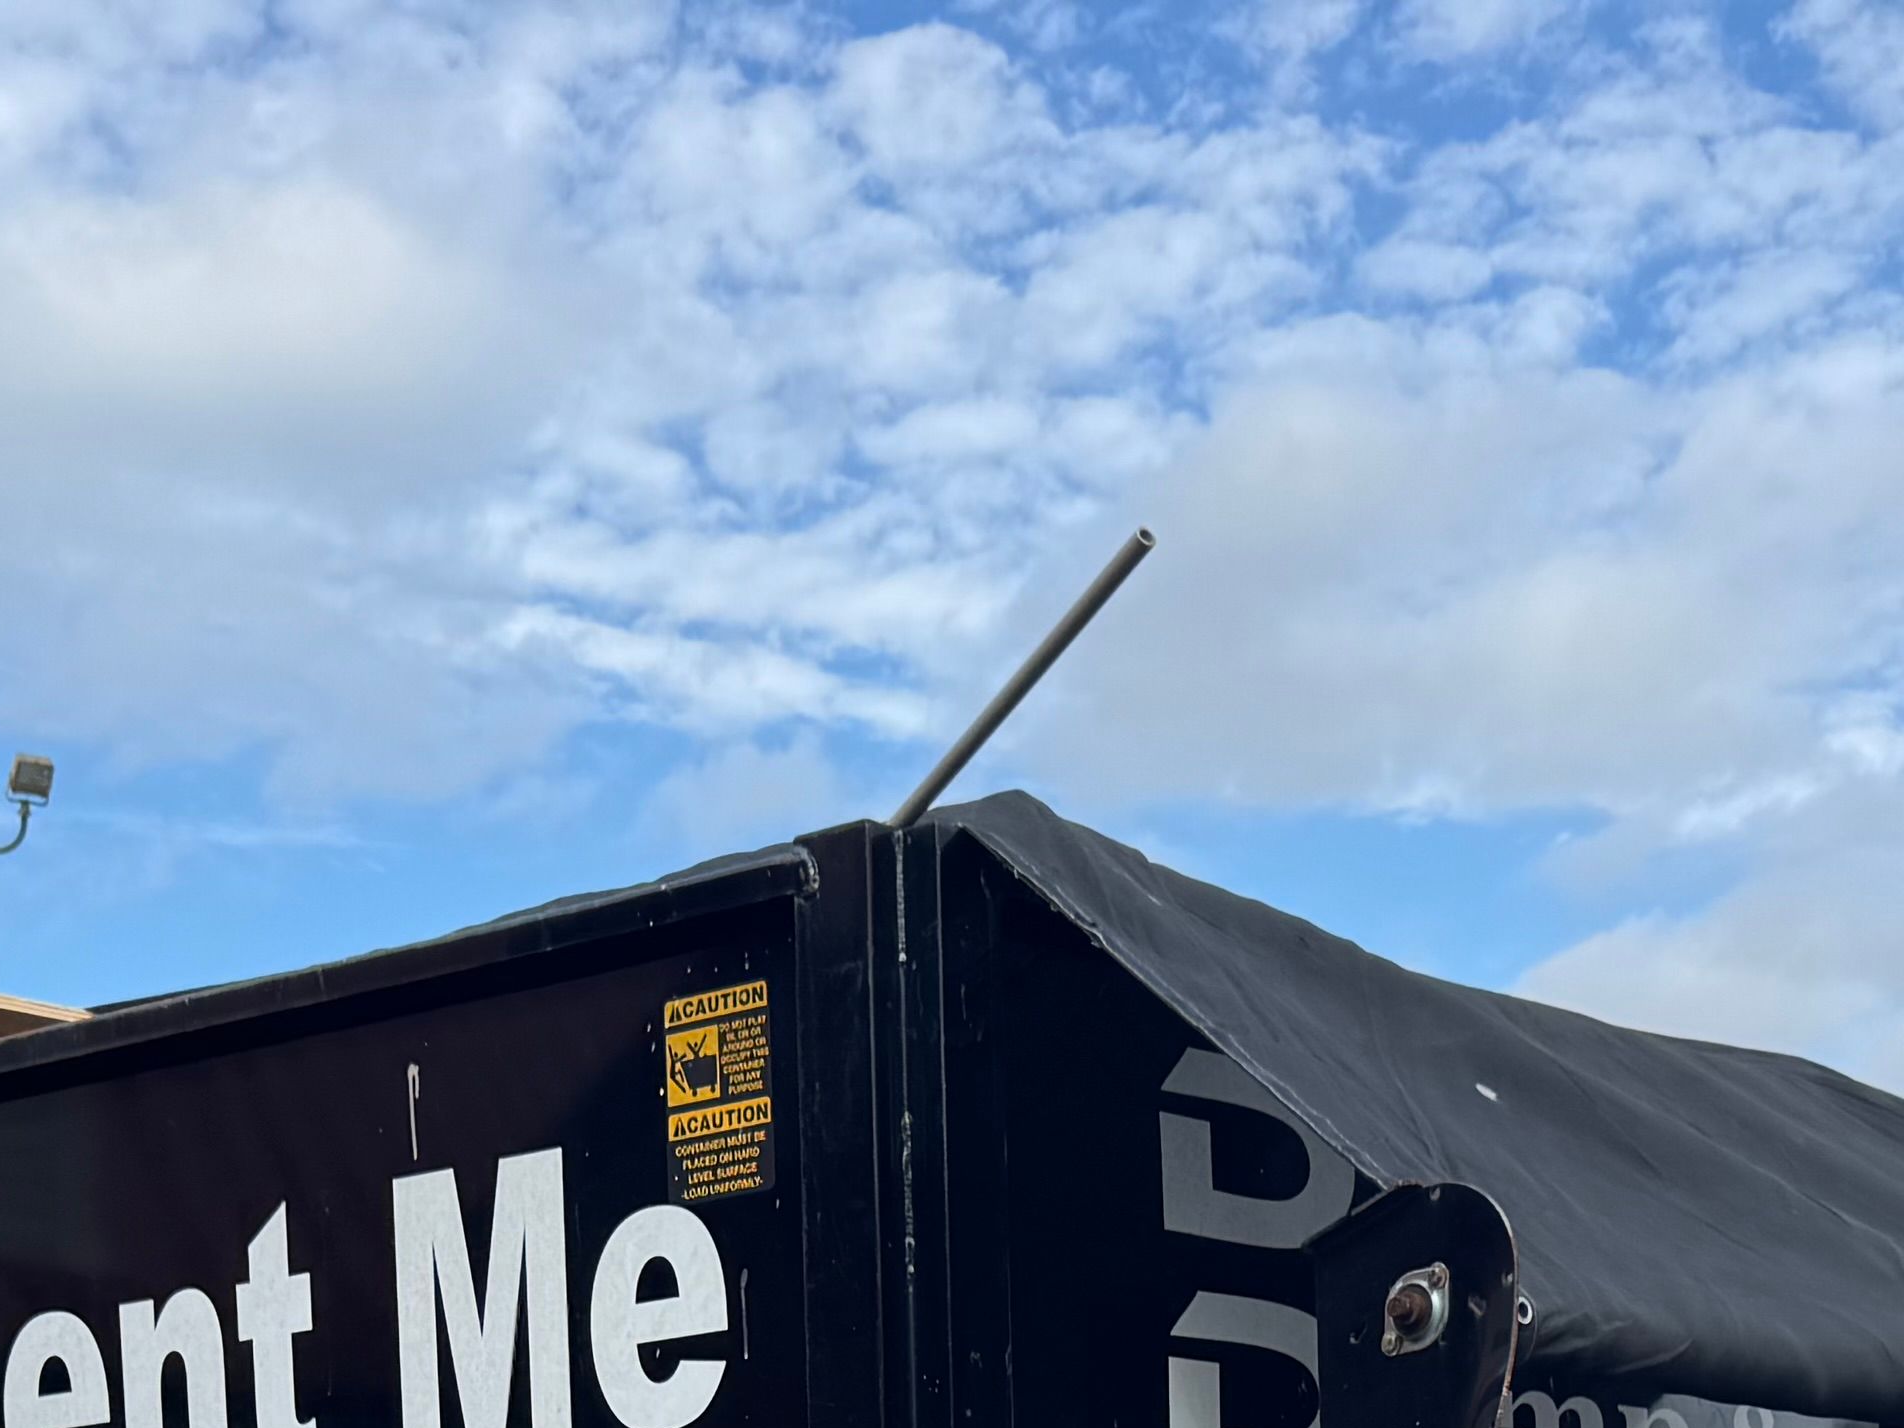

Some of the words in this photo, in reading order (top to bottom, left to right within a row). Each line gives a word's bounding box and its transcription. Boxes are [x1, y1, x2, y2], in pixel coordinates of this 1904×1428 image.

[682, 984, 765, 1018] CAUTION
[686, 1102, 769, 1134] CAUTION
[726, 1131, 752, 1147] MUST
[682, 1154, 718, 1170] PLACED
[688, 1170, 715, 1185] LEVEL
